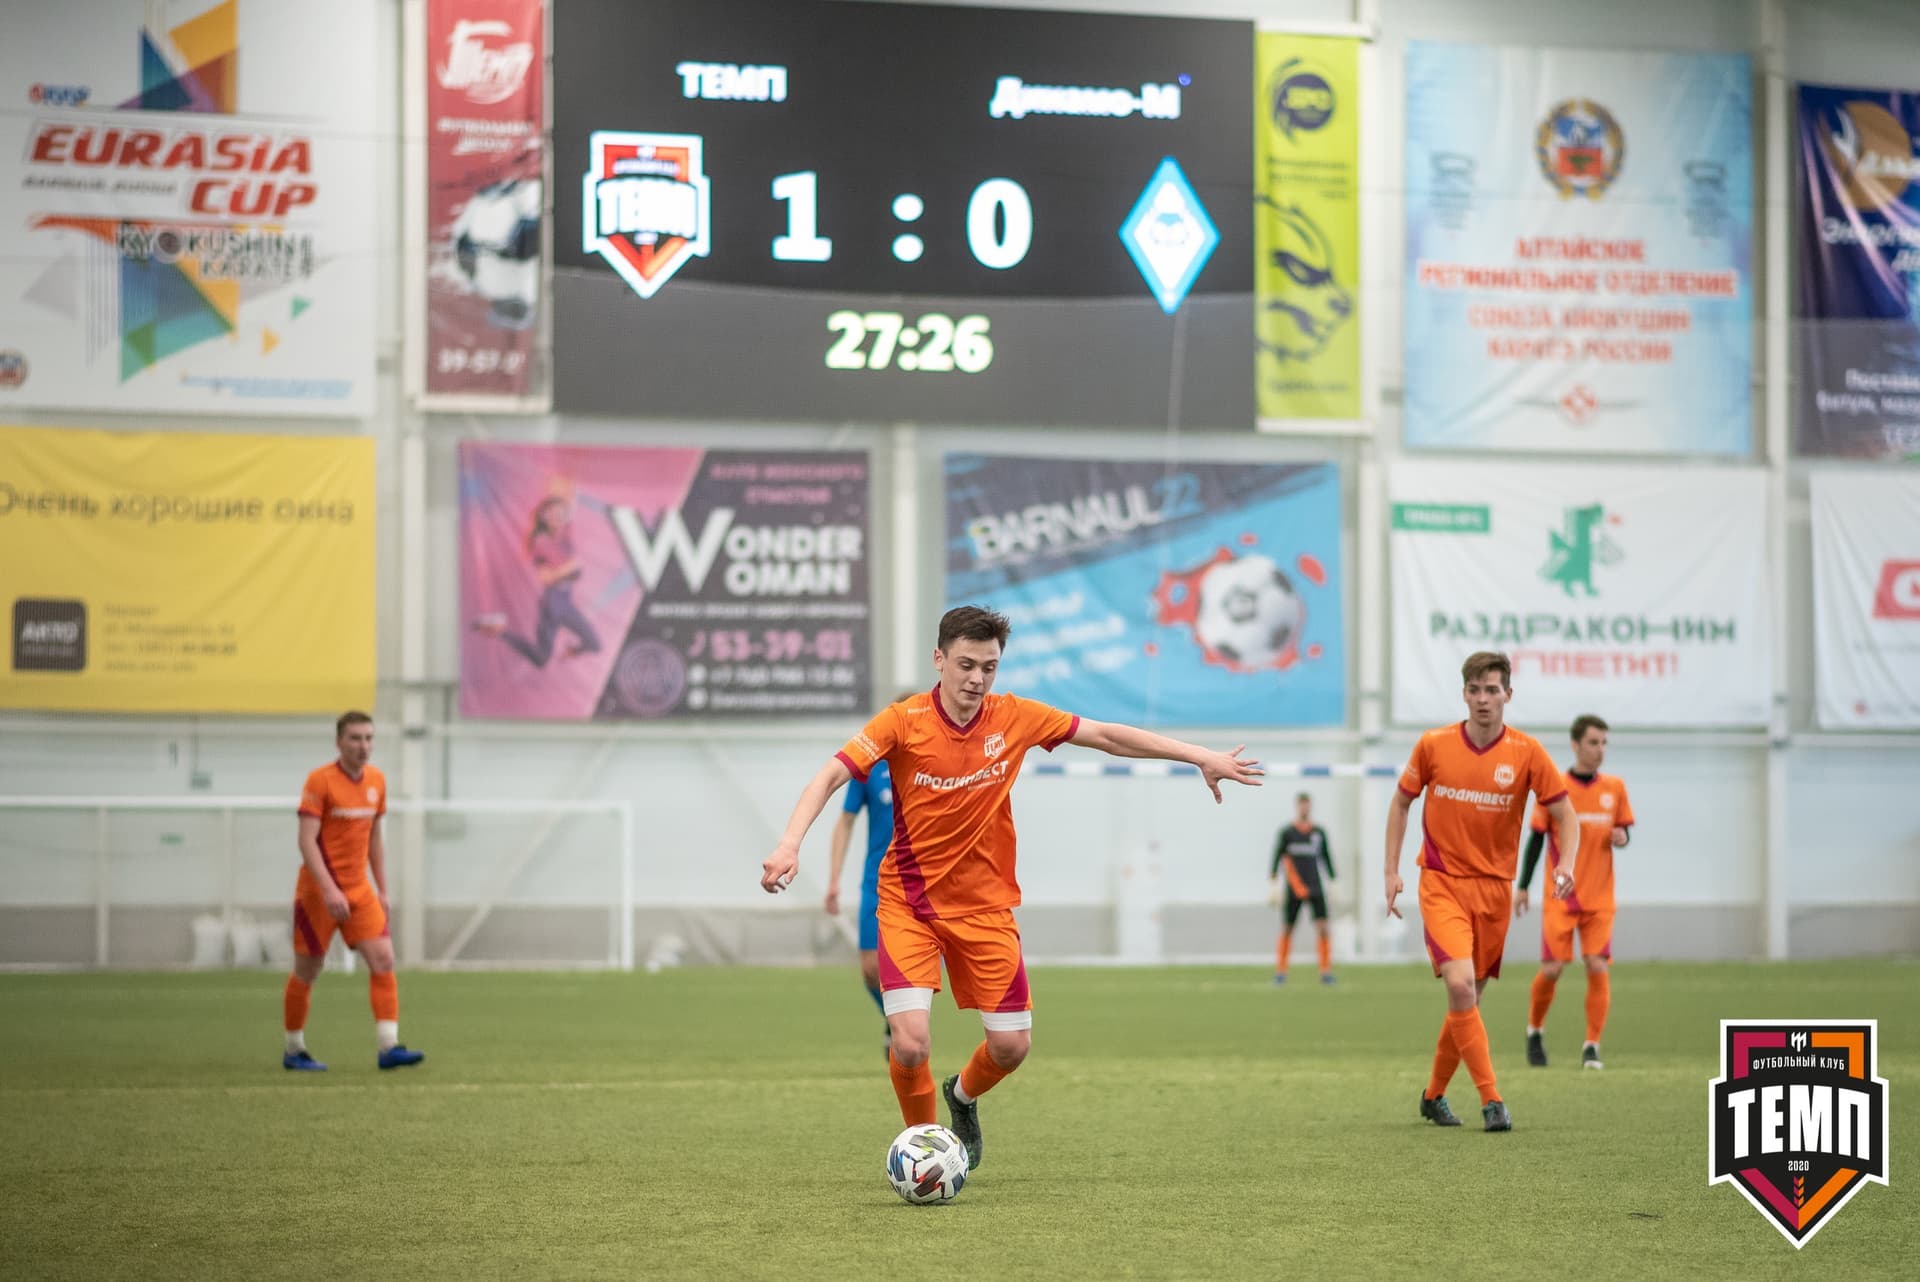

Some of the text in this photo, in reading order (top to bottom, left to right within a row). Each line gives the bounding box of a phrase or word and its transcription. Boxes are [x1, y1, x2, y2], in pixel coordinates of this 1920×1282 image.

[676, 61, 788, 102] ТЕМП
[989, 75, 1182, 119] Динамо-М
[31, 125, 312, 174] EURASIA
[190, 179, 318, 217] CUP
[771, 170, 833, 263] 1
[966, 177, 1033, 271] 0
[826, 311, 994, 374] 27:26
[109, 491, 265, 526] хорошие
[914, 760, 1009, 790] ПРОДИНВЕСТ
[1433, 784, 1515, 806] ПРОДИНВЕСТ
